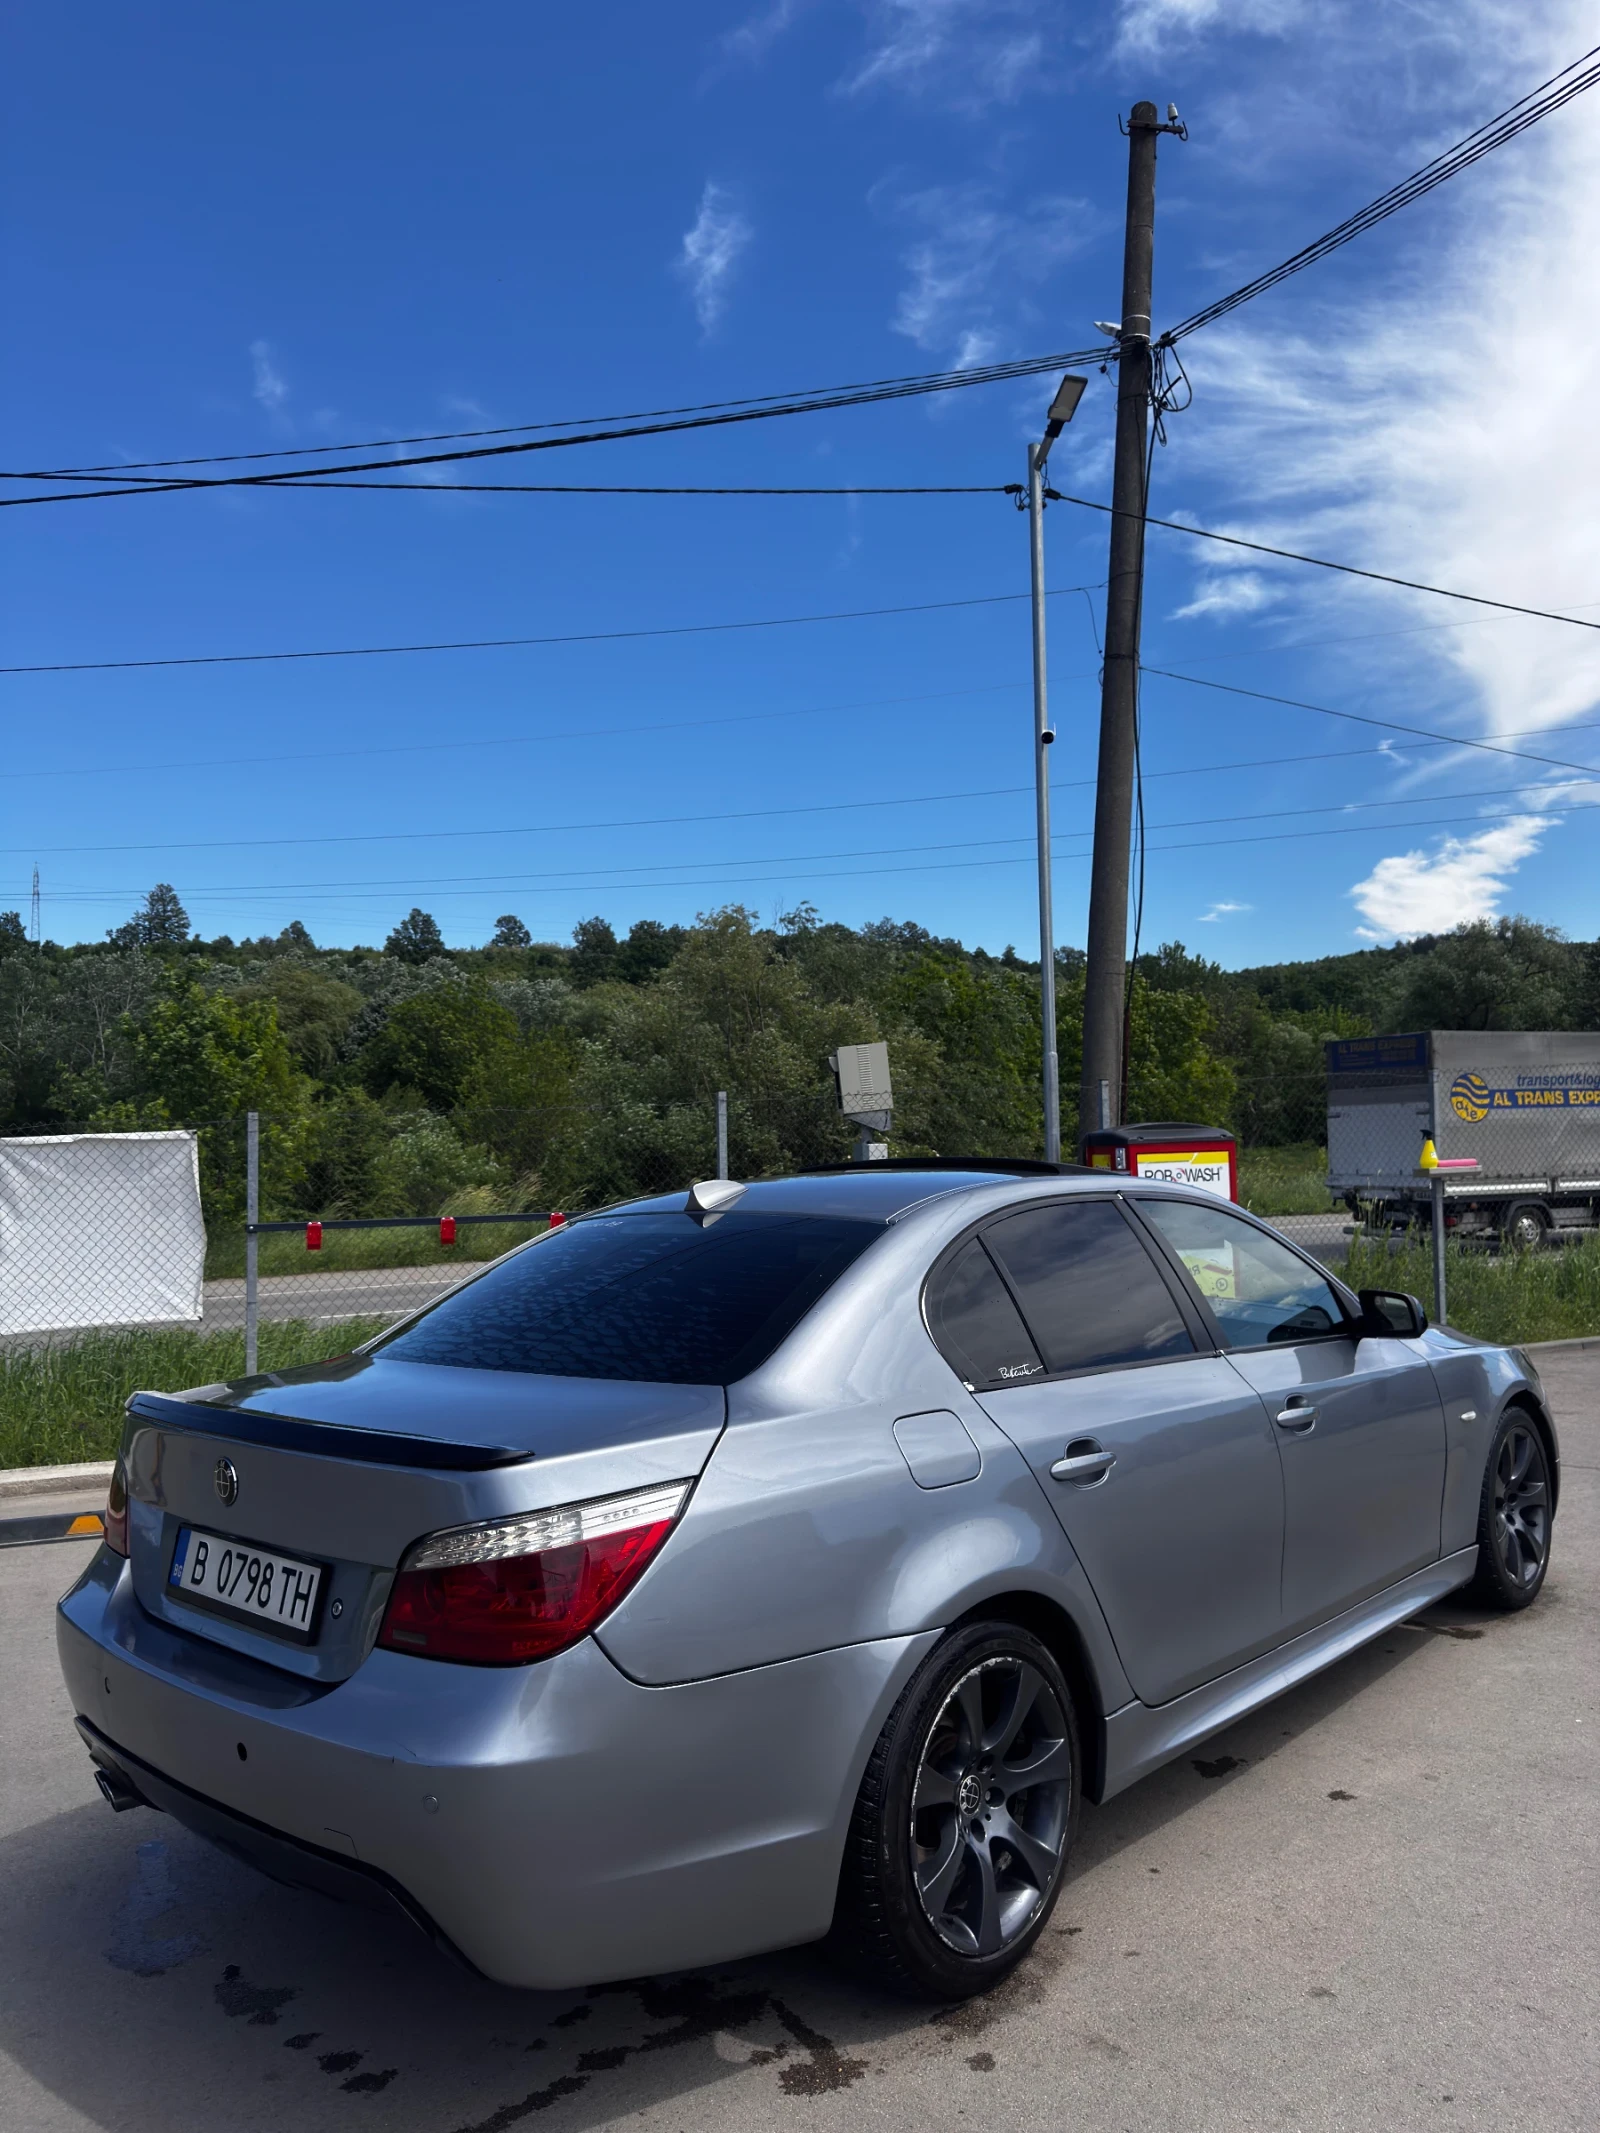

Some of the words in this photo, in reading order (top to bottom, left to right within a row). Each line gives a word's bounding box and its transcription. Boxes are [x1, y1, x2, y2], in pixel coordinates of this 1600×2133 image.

[1493, 1092, 1512, 1107] AL
[1515, 1091, 1564, 1106] TRANS
[173, 1563, 183, 1578] BG
[190, 1540, 209, 1586] B
[217, 1549, 275, 1609] 0798
[279, 1565, 315, 1623] TH
